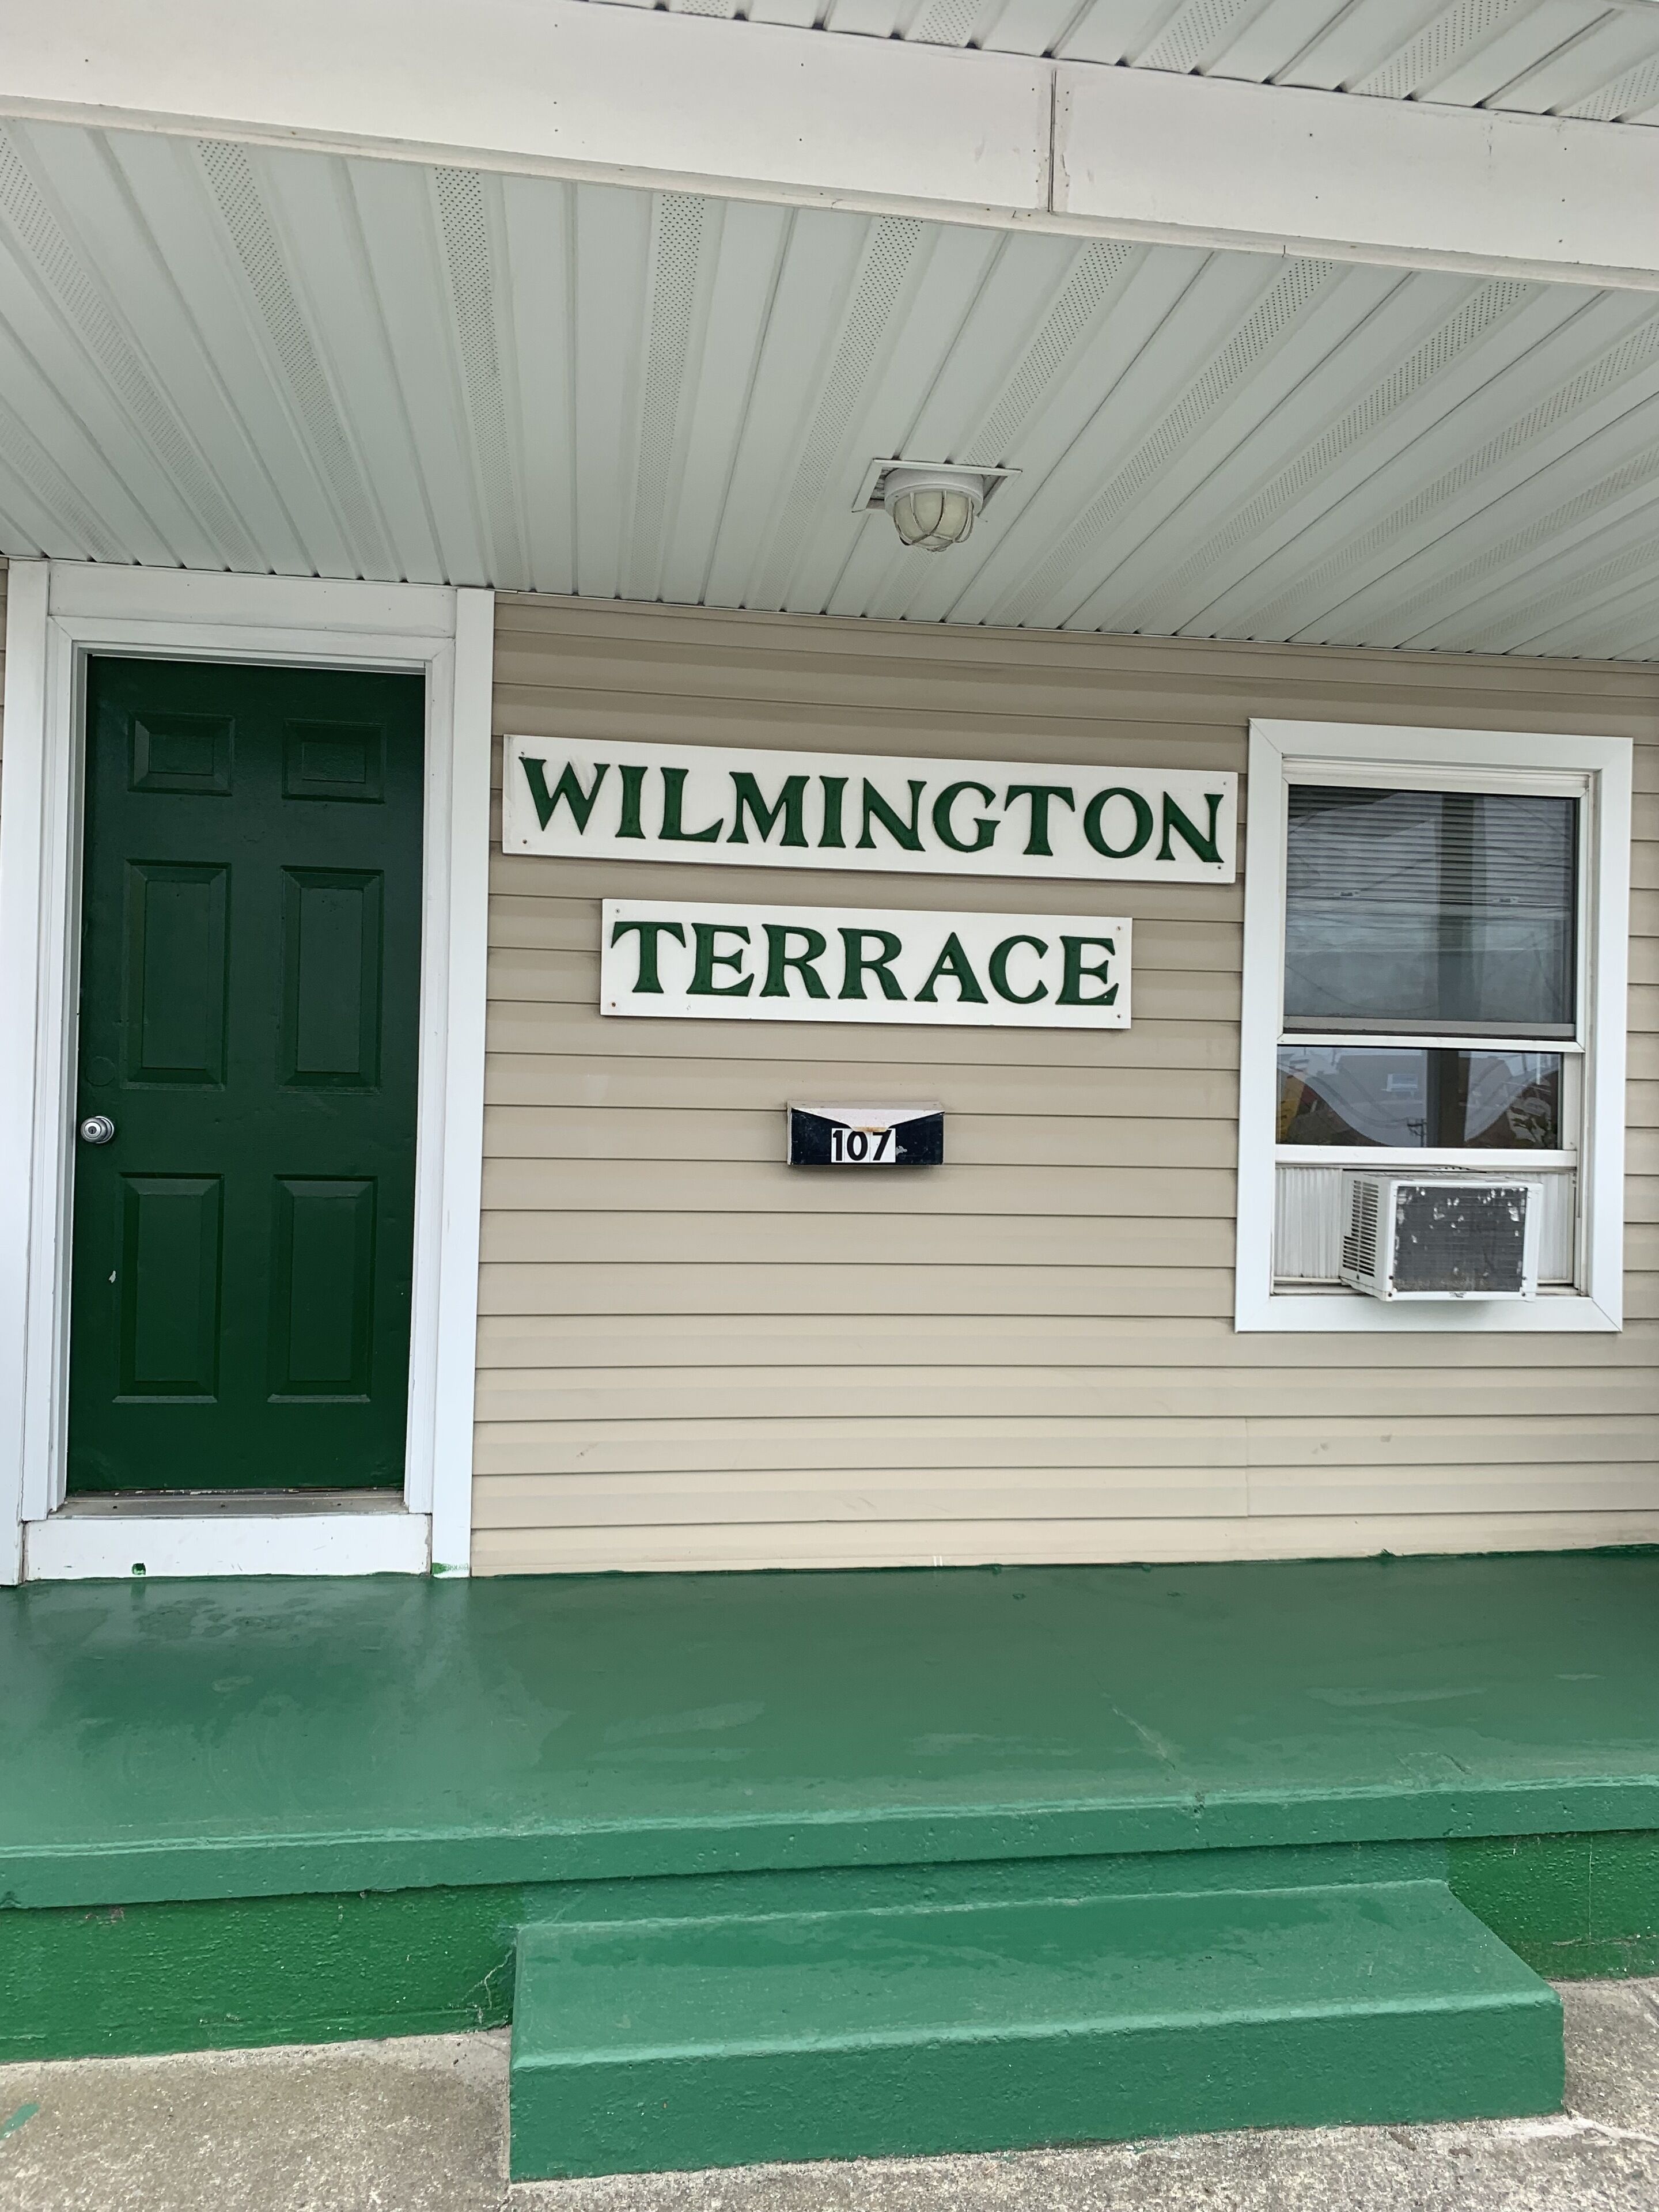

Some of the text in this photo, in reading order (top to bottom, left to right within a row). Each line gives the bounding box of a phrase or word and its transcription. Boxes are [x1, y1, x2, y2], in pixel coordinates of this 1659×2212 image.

[518, 756, 1225, 863] WILMINGTON
[611, 922, 1120, 1006] TERRACE
[832, 1130, 892, 1161] 107
